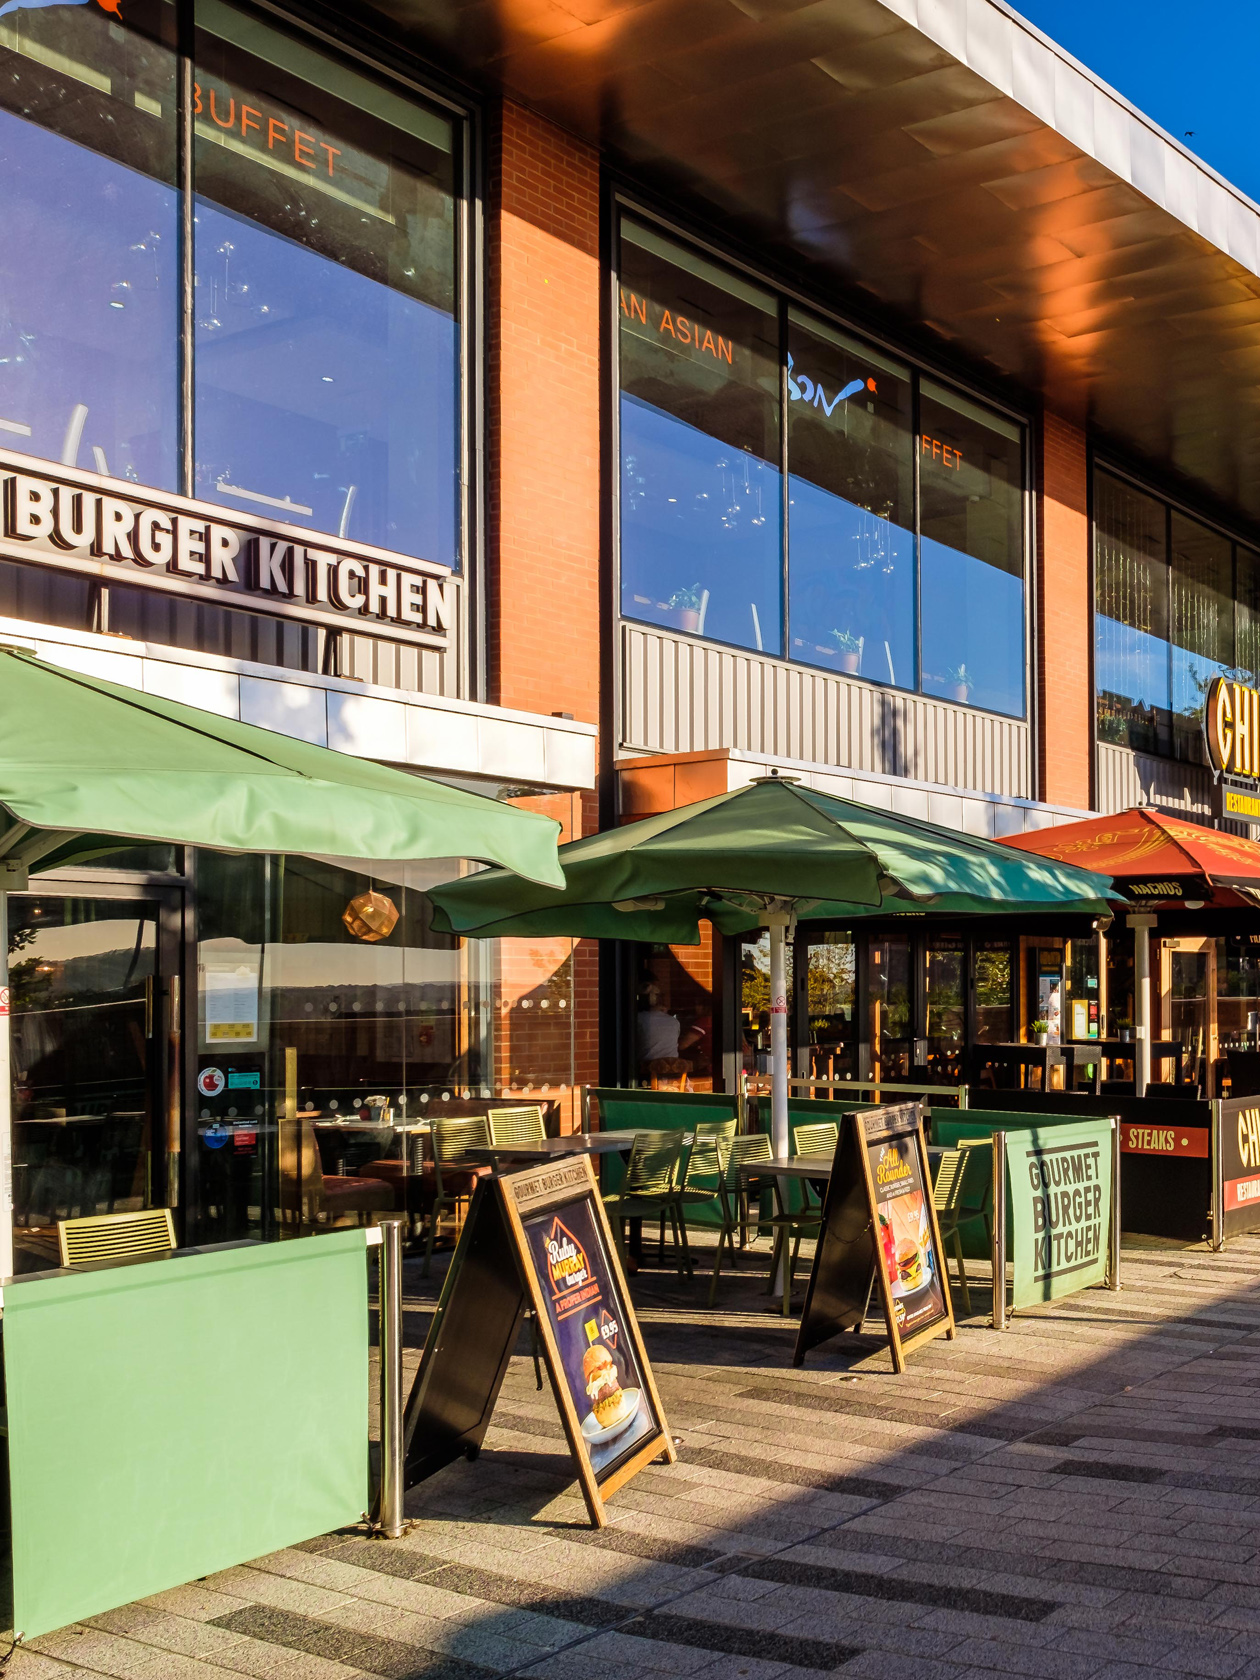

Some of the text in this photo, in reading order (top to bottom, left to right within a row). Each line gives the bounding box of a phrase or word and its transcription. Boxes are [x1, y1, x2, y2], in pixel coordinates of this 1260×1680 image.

[660, 309, 732, 365] ASIAN
[11, 475, 450, 631] BURGER KITCHEN
[1129, 882, 1183, 896] NACHOS
[1128, 1128, 1175, 1151] STEAKS
[876, 1159, 913, 1184] Rounder
[882, 1147, 899, 1169] All
[1028, 1151, 1100, 1191] GOURMET
[514, 1164, 588, 1200] GOURMET BURGER KITCHEN
[1032, 1184, 1102, 1234] BURGER
[548, 1237, 577, 1265] Ruby
[1033, 1221, 1101, 1272] KITCHEN
[552, 1252, 585, 1282] MURRAY
[600, 1319, 619, 1340] £9.95
